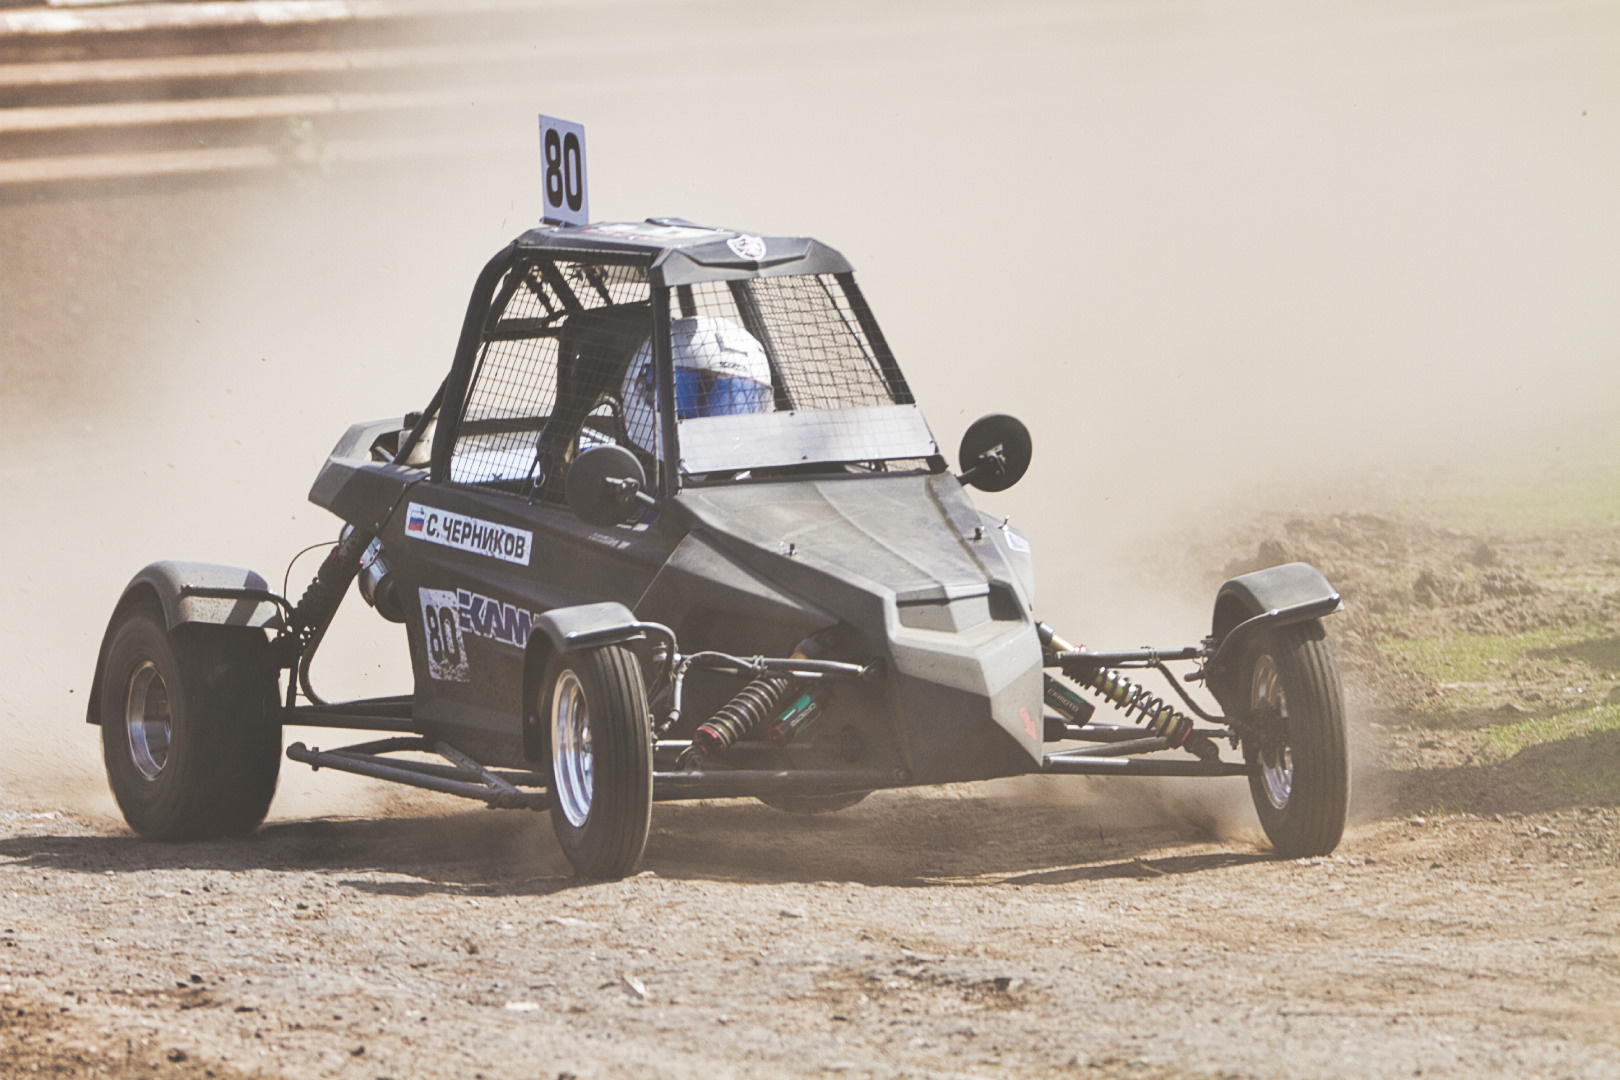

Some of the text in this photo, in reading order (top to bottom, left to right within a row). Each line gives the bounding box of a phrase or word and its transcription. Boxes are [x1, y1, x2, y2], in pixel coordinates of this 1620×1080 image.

[544, 128, 583, 212] 80
[425, 603, 462, 665] 80
[457, 588, 541, 649] KAM
